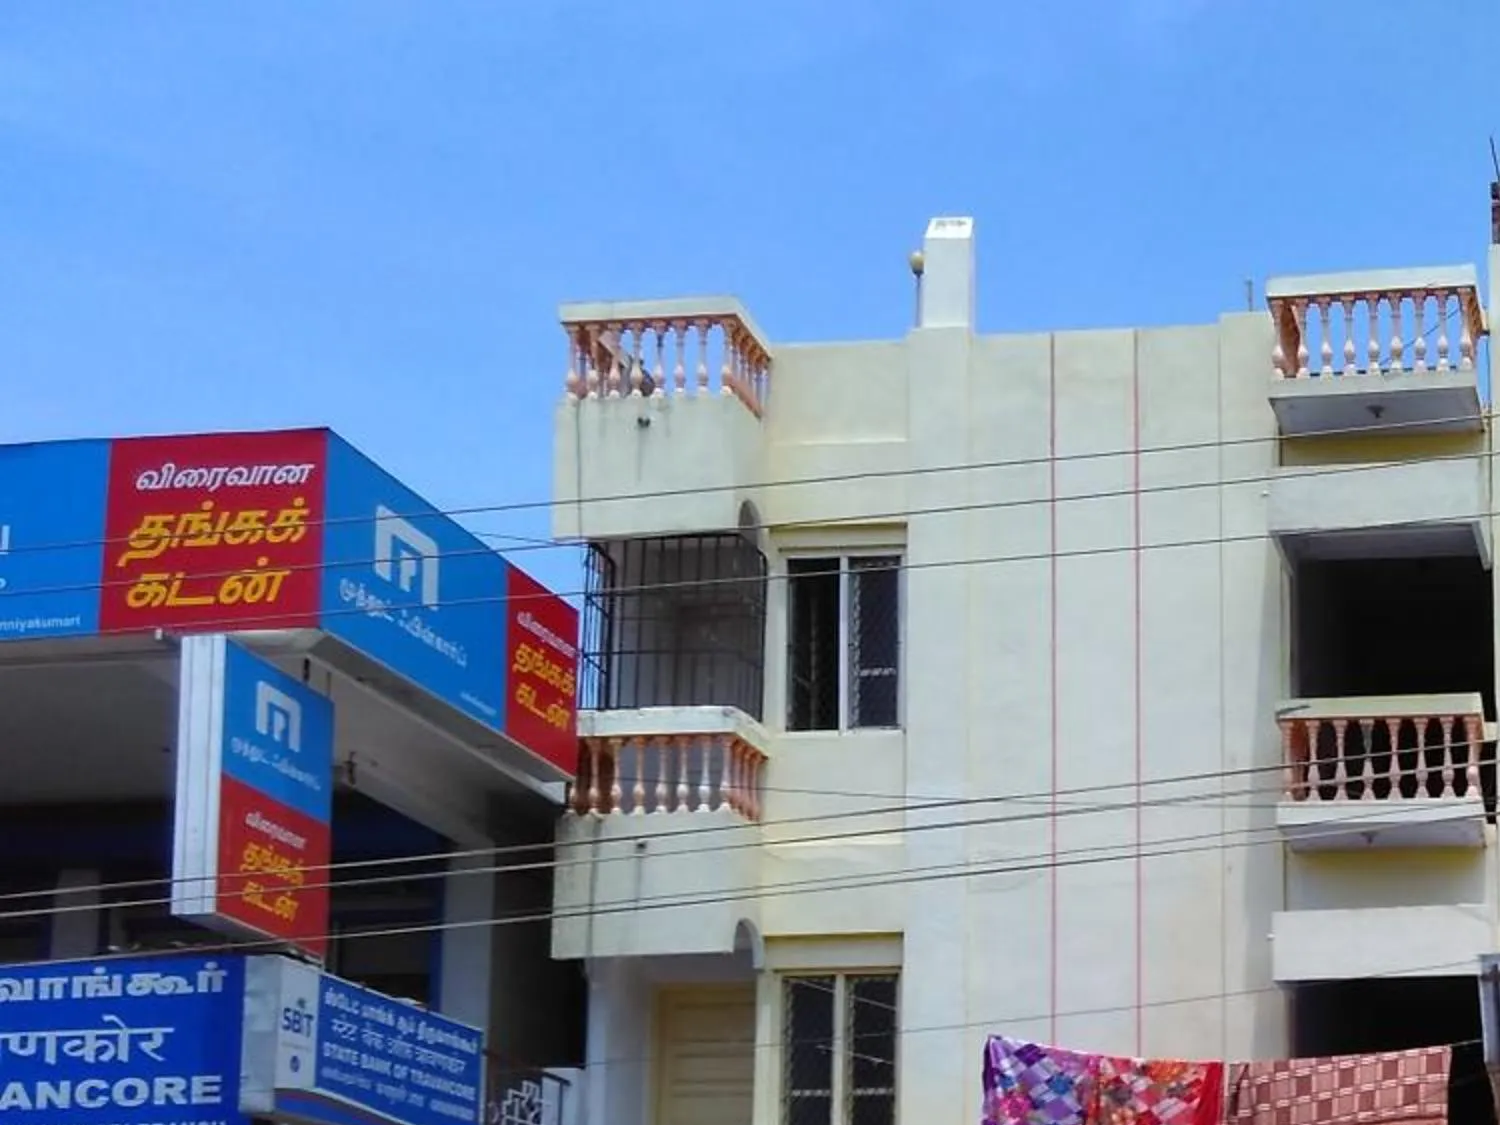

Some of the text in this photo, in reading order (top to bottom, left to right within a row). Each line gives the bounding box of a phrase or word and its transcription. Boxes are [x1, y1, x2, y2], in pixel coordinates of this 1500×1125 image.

[136, 463, 315, 491] விரைவான
[116, 497, 310, 567] தங்கக்
[126, 556, 291, 608] கடன்
[0, 1014, 175, 1064] णकोर
[0, 1075, 222, 1110] ANCORE
